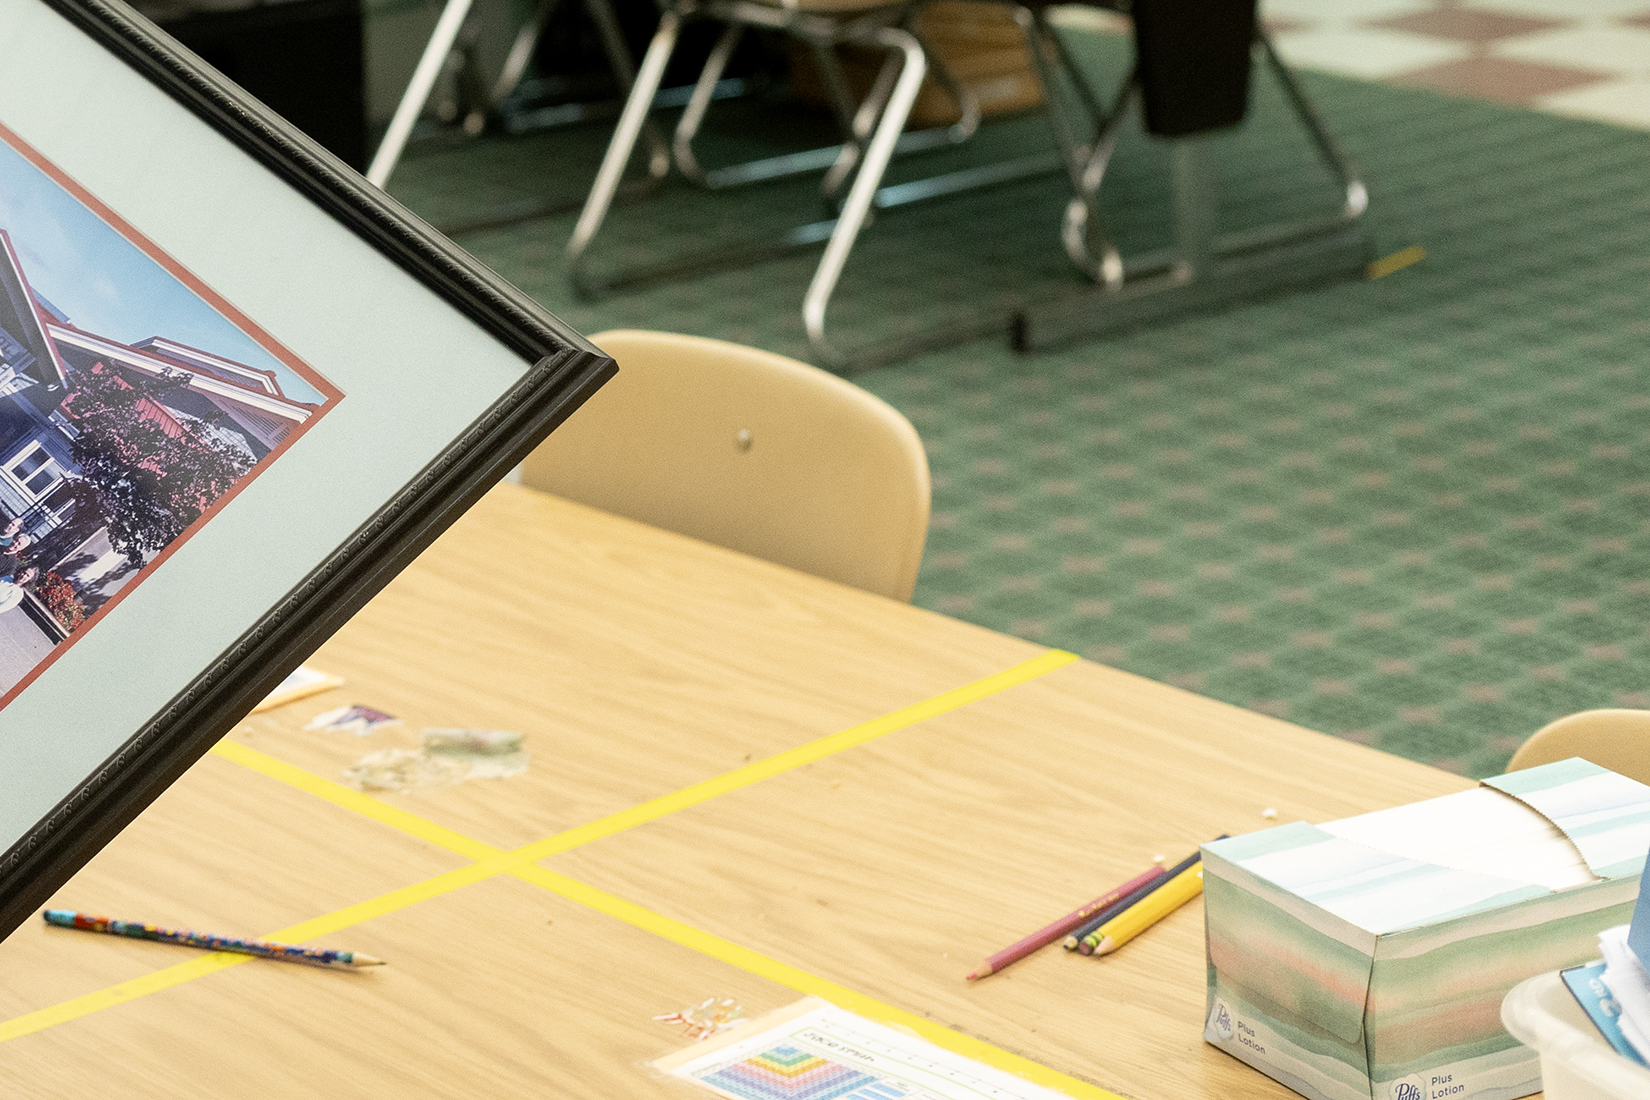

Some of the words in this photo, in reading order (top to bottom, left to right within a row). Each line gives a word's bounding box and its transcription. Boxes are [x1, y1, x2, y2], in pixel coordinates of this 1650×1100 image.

[1216, 1003, 1232, 1032] Puffs
[1237, 1020, 1256, 1038] Plus
[1237, 1032, 1267, 1055] Lotion
[1431, 1074, 1453, 1087] Plus
[1431, 1084, 1465, 1100] Lotion
